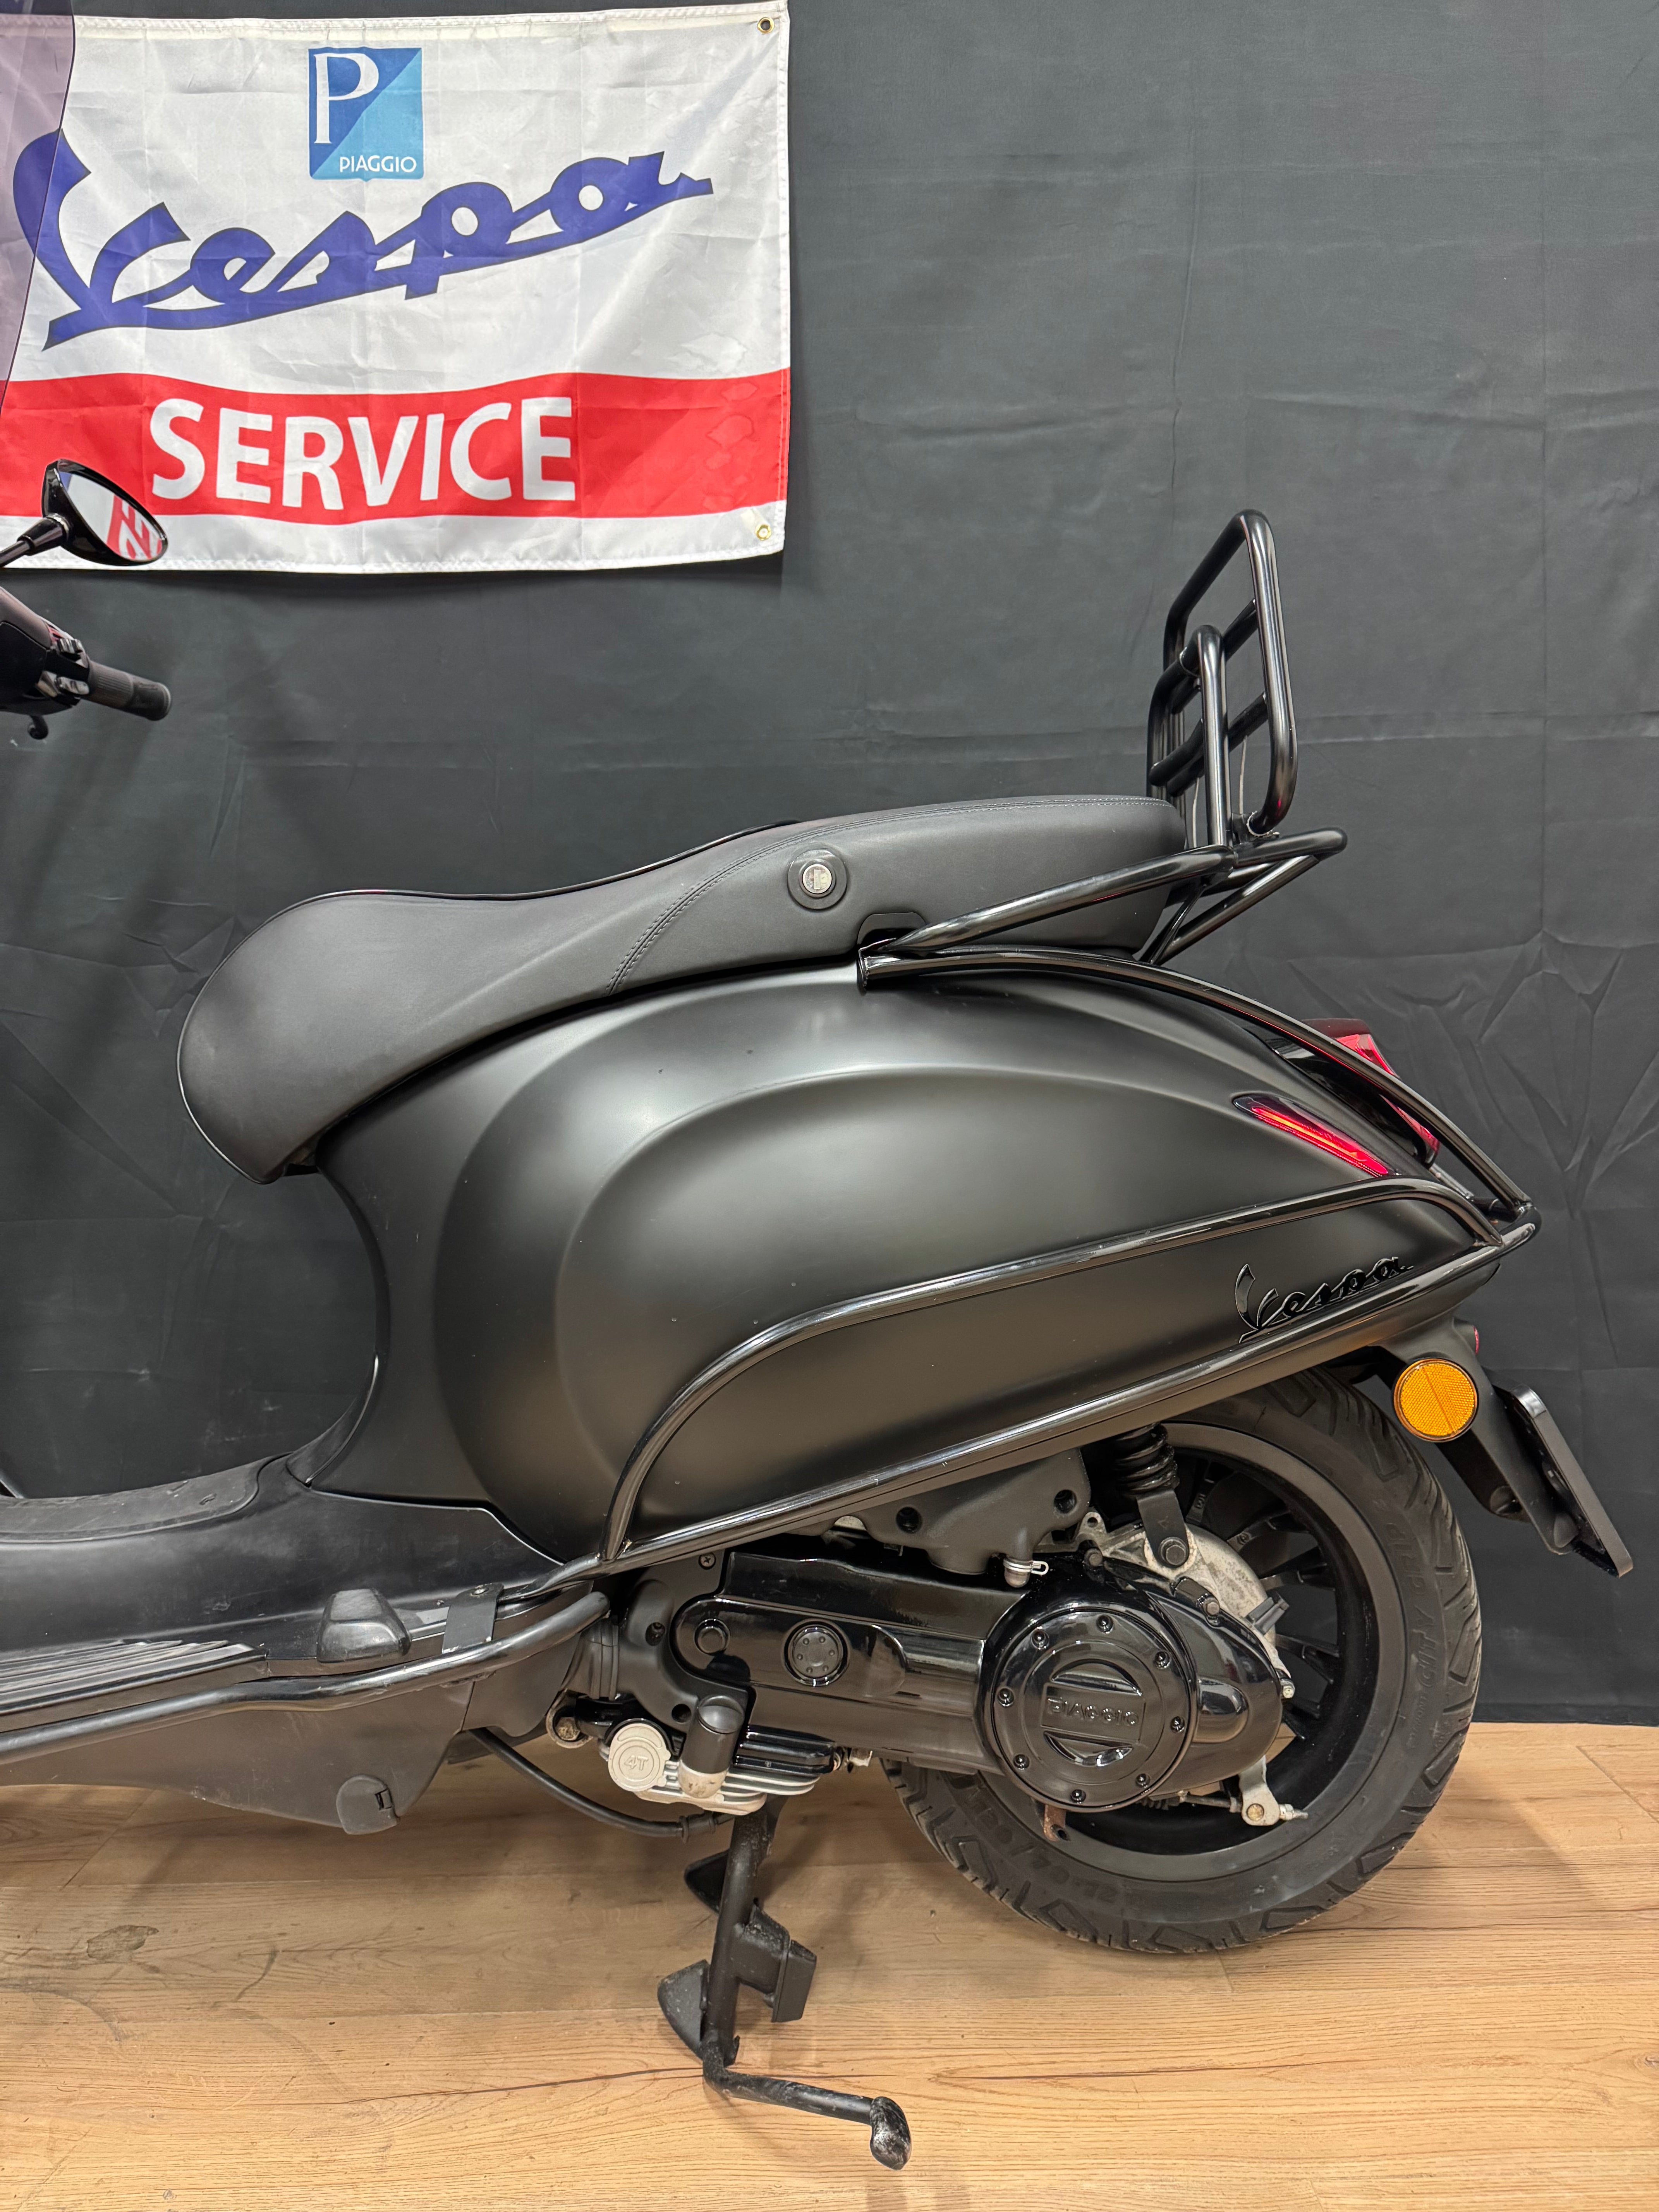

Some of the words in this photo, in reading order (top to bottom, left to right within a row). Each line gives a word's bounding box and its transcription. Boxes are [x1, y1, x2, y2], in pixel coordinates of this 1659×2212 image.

[313, 53, 379, 144] P
[340, 155, 417, 173] PIAGGIO
[13, 129, 714, 351] Vespa
[151, 397, 577, 511] SERVICE
[1235, 1256, 1414, 1344] Vespa
[1046, 1696, 1140, 1726] PIAGGIO
[624, 1755, 649, 1771] 4T
